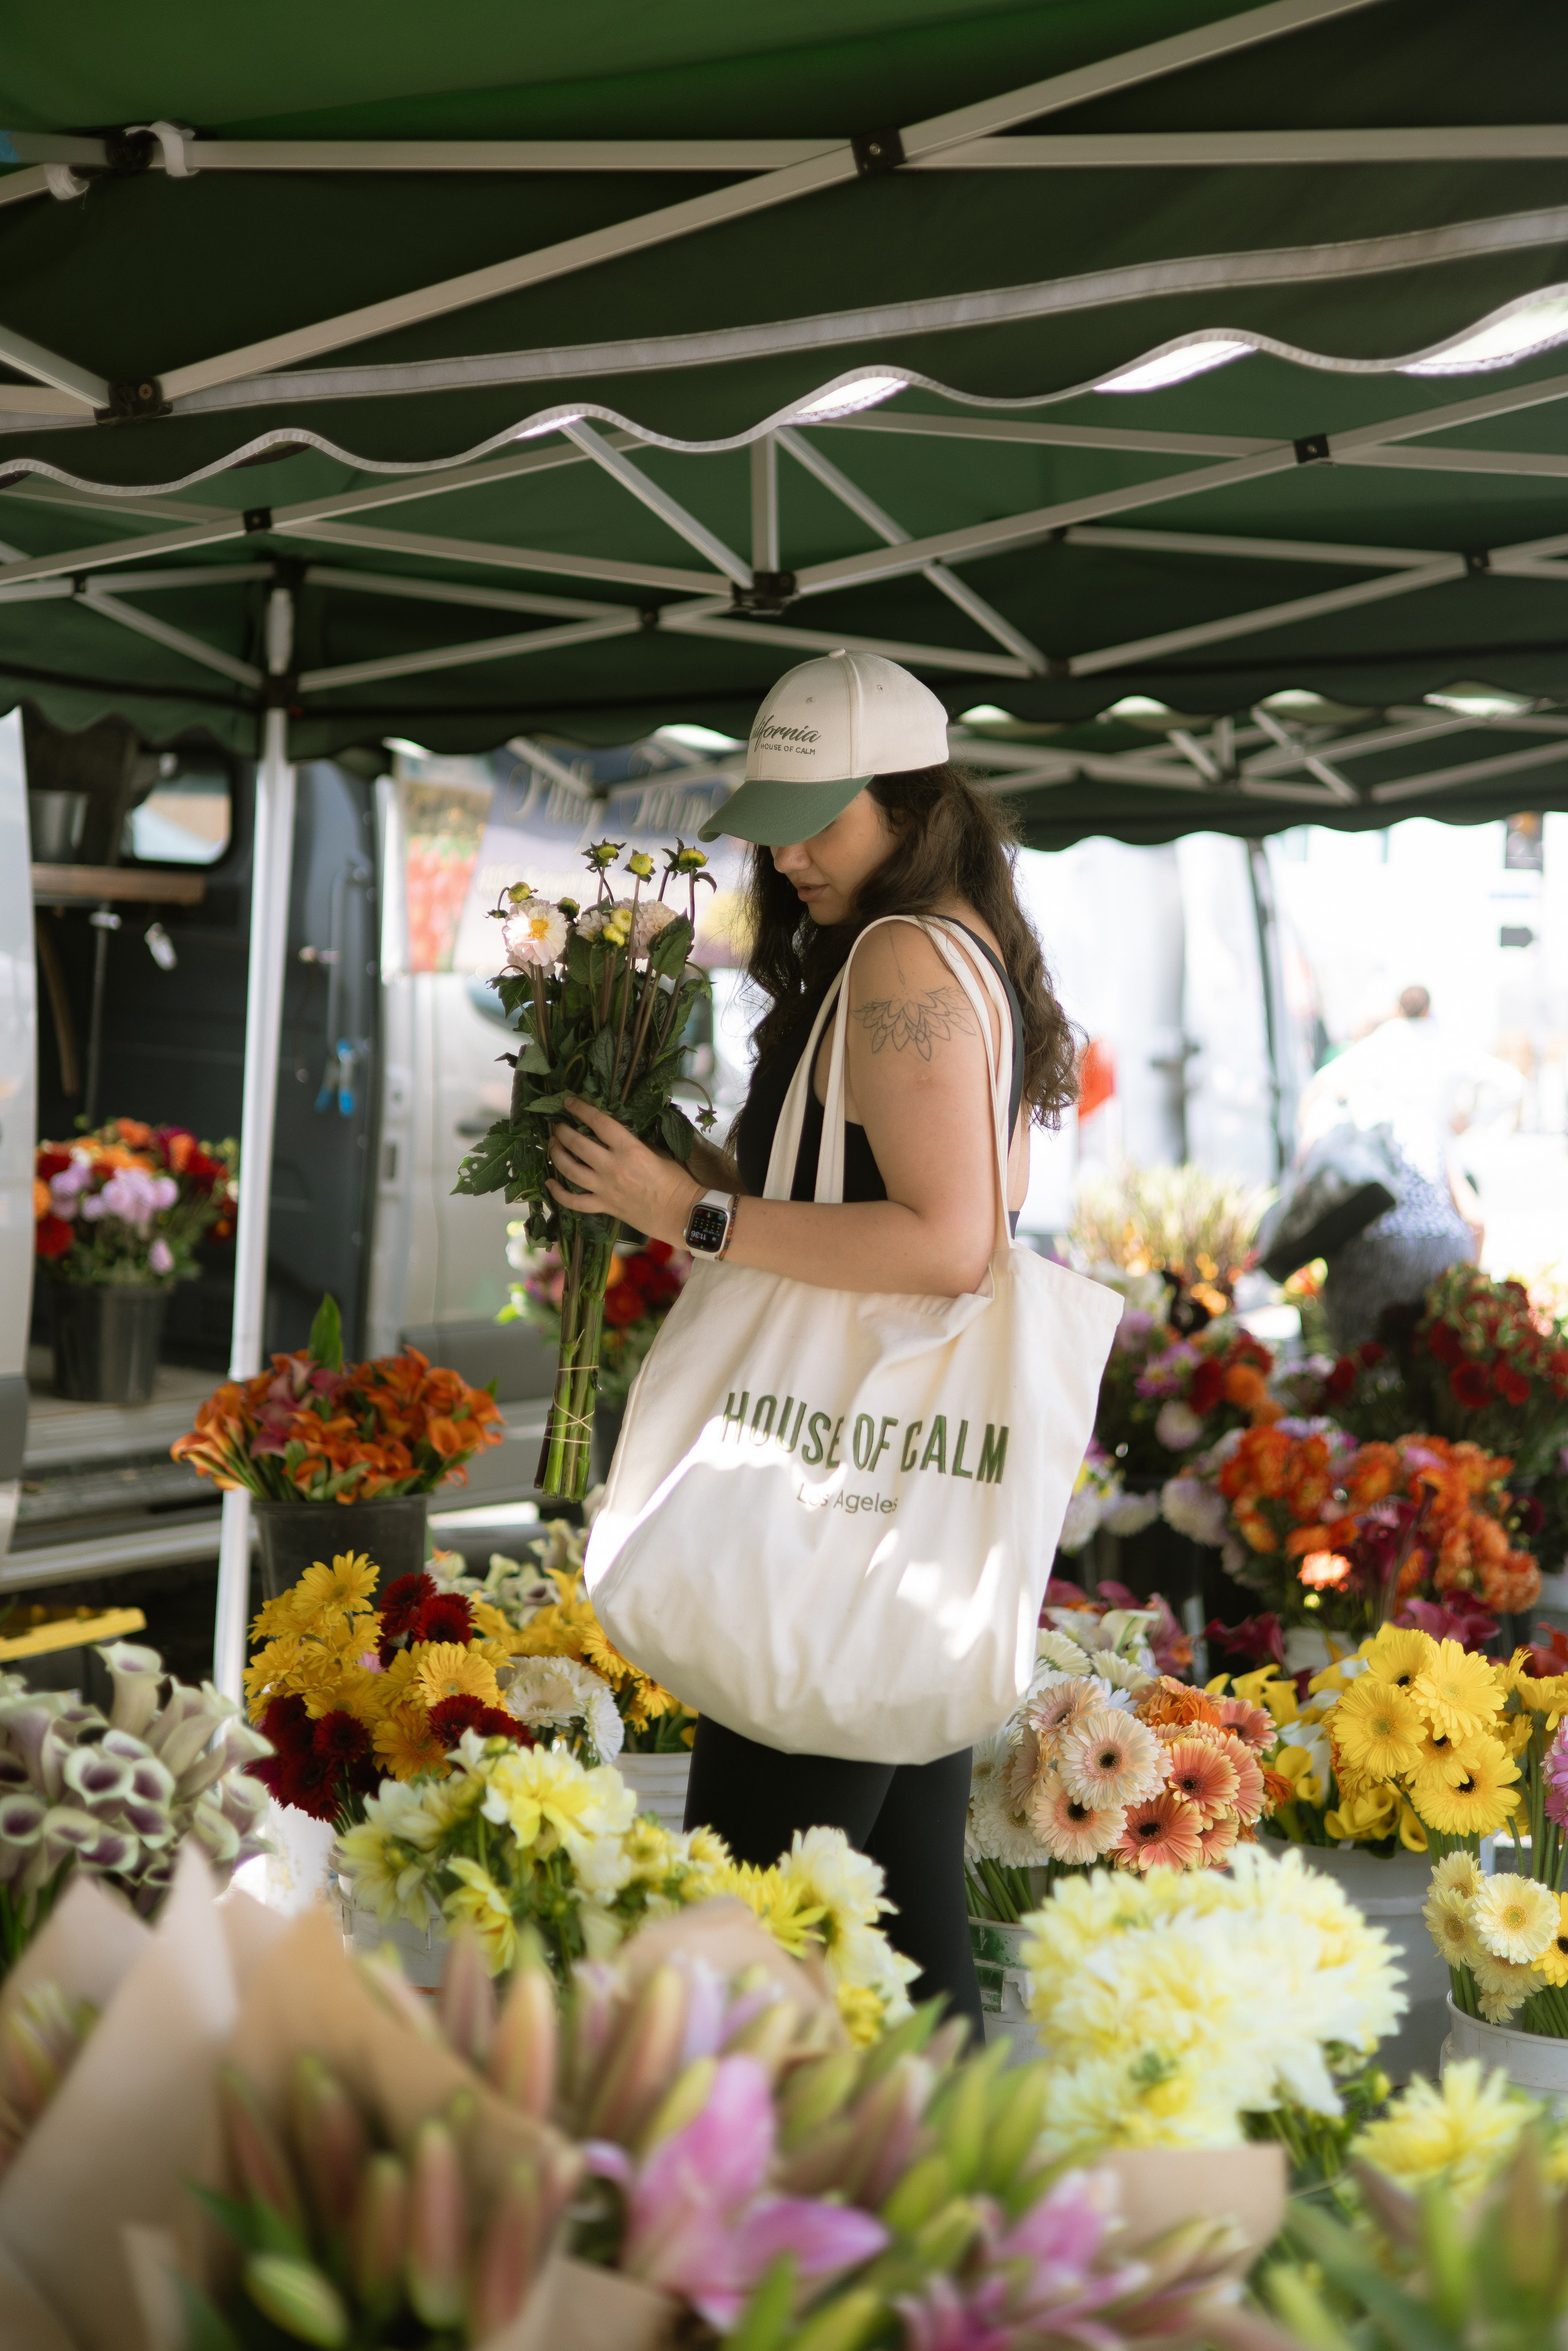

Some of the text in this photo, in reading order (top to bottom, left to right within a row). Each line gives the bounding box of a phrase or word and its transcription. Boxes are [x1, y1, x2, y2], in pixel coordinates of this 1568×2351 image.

[796, 747, 815, 755] CALM
[691, 1230, 707, 1240] 11:36
[720, 1391, 1009, 1484] HOUSE OF CALM
[797, 1482, 898, 1513] Los Ageles
